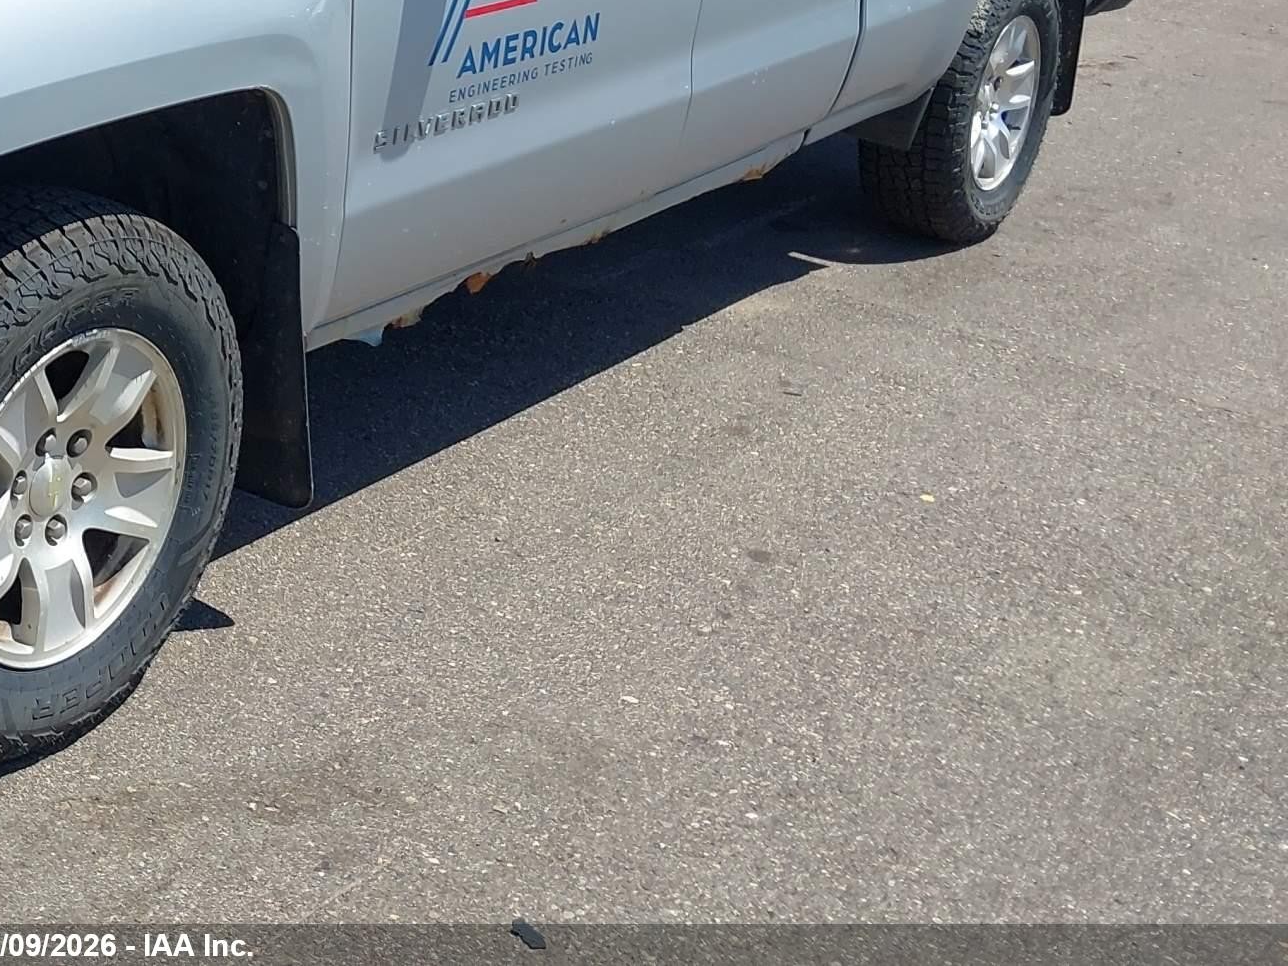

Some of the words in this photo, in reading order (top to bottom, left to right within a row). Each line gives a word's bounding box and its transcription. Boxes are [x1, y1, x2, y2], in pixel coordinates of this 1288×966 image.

[456, 12, 601, 79] AMERICAN
[448, 68, 538, 103] ENGINEERING
[544, 52, 593, 76] TESTING
